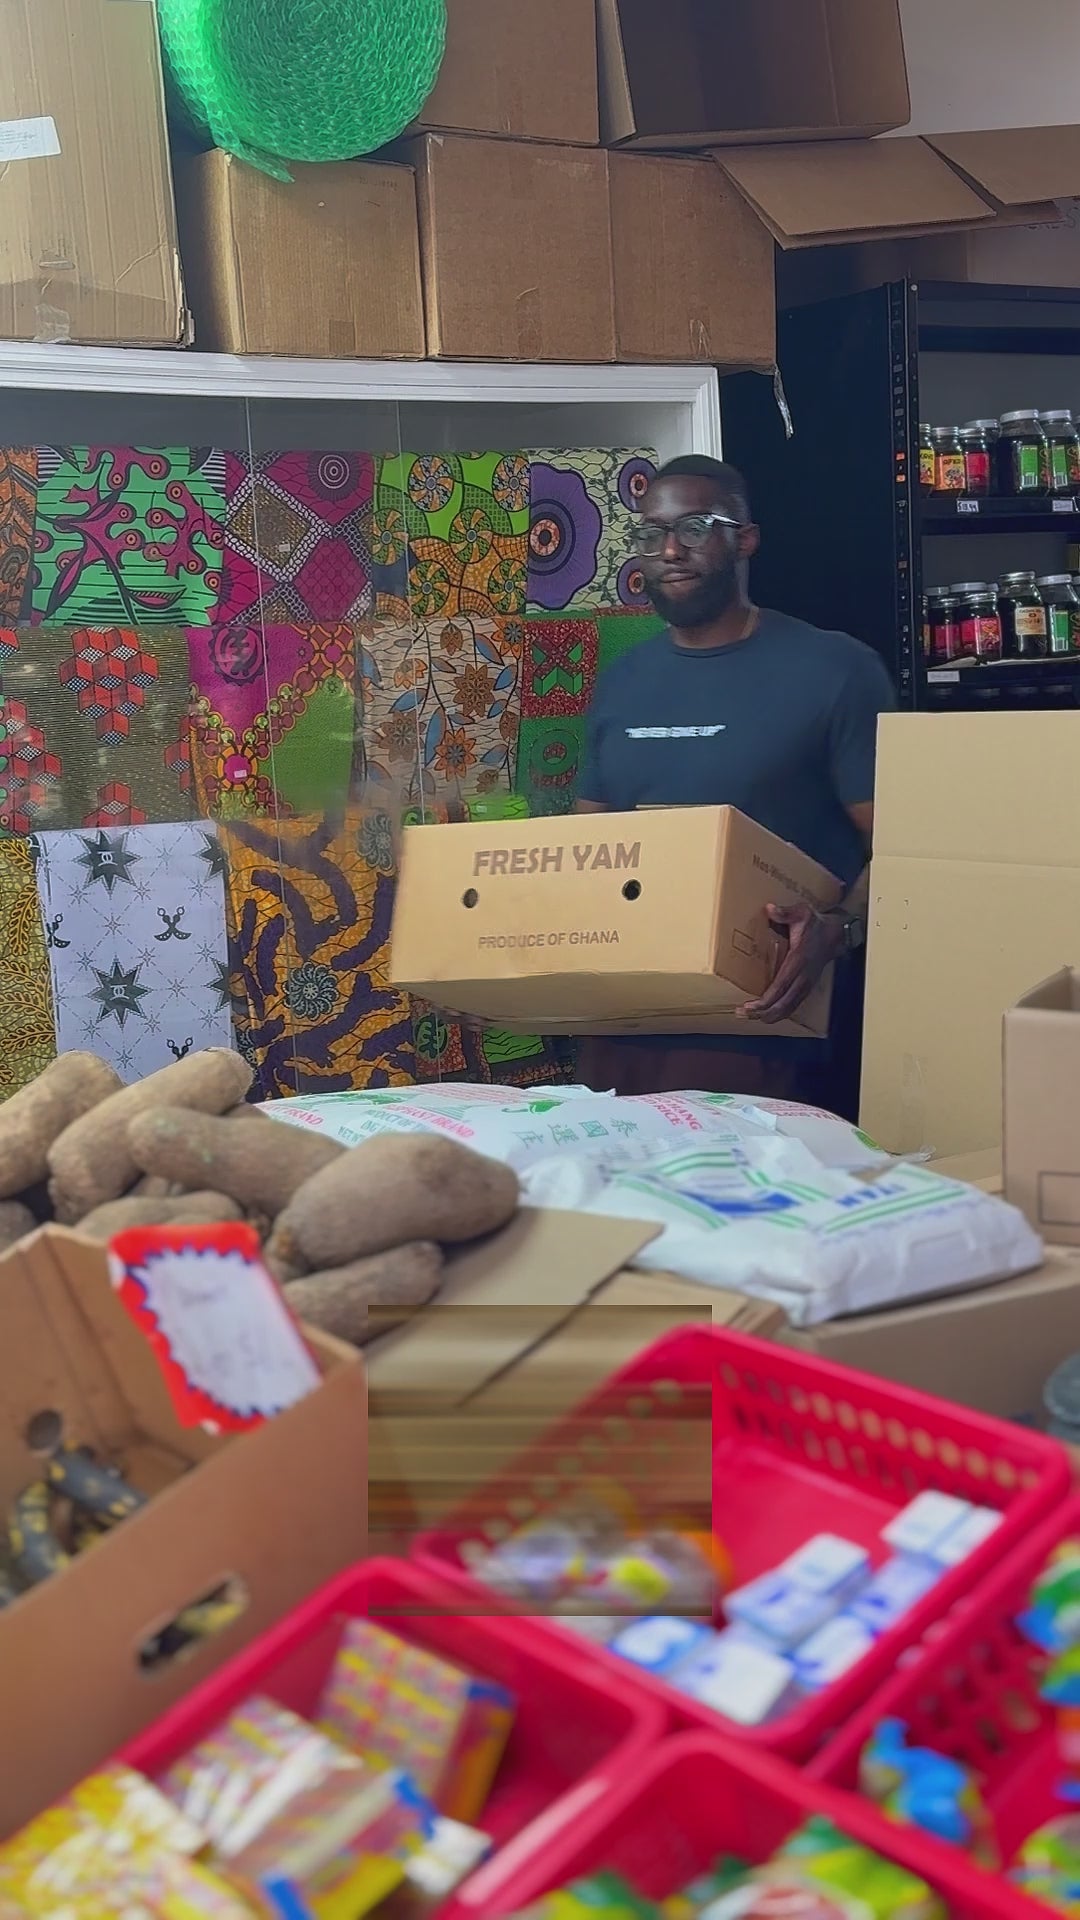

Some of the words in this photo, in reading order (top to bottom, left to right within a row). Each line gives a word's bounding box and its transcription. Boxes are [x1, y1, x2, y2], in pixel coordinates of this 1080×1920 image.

[472, 846, 564, 876] FRESH
[572, 841, 642, 871] YAM
[478, 933, 545, 949] PRODUCE
[547, 932, 567, 947] OF
[568, 929, 620, 945] GHANA
